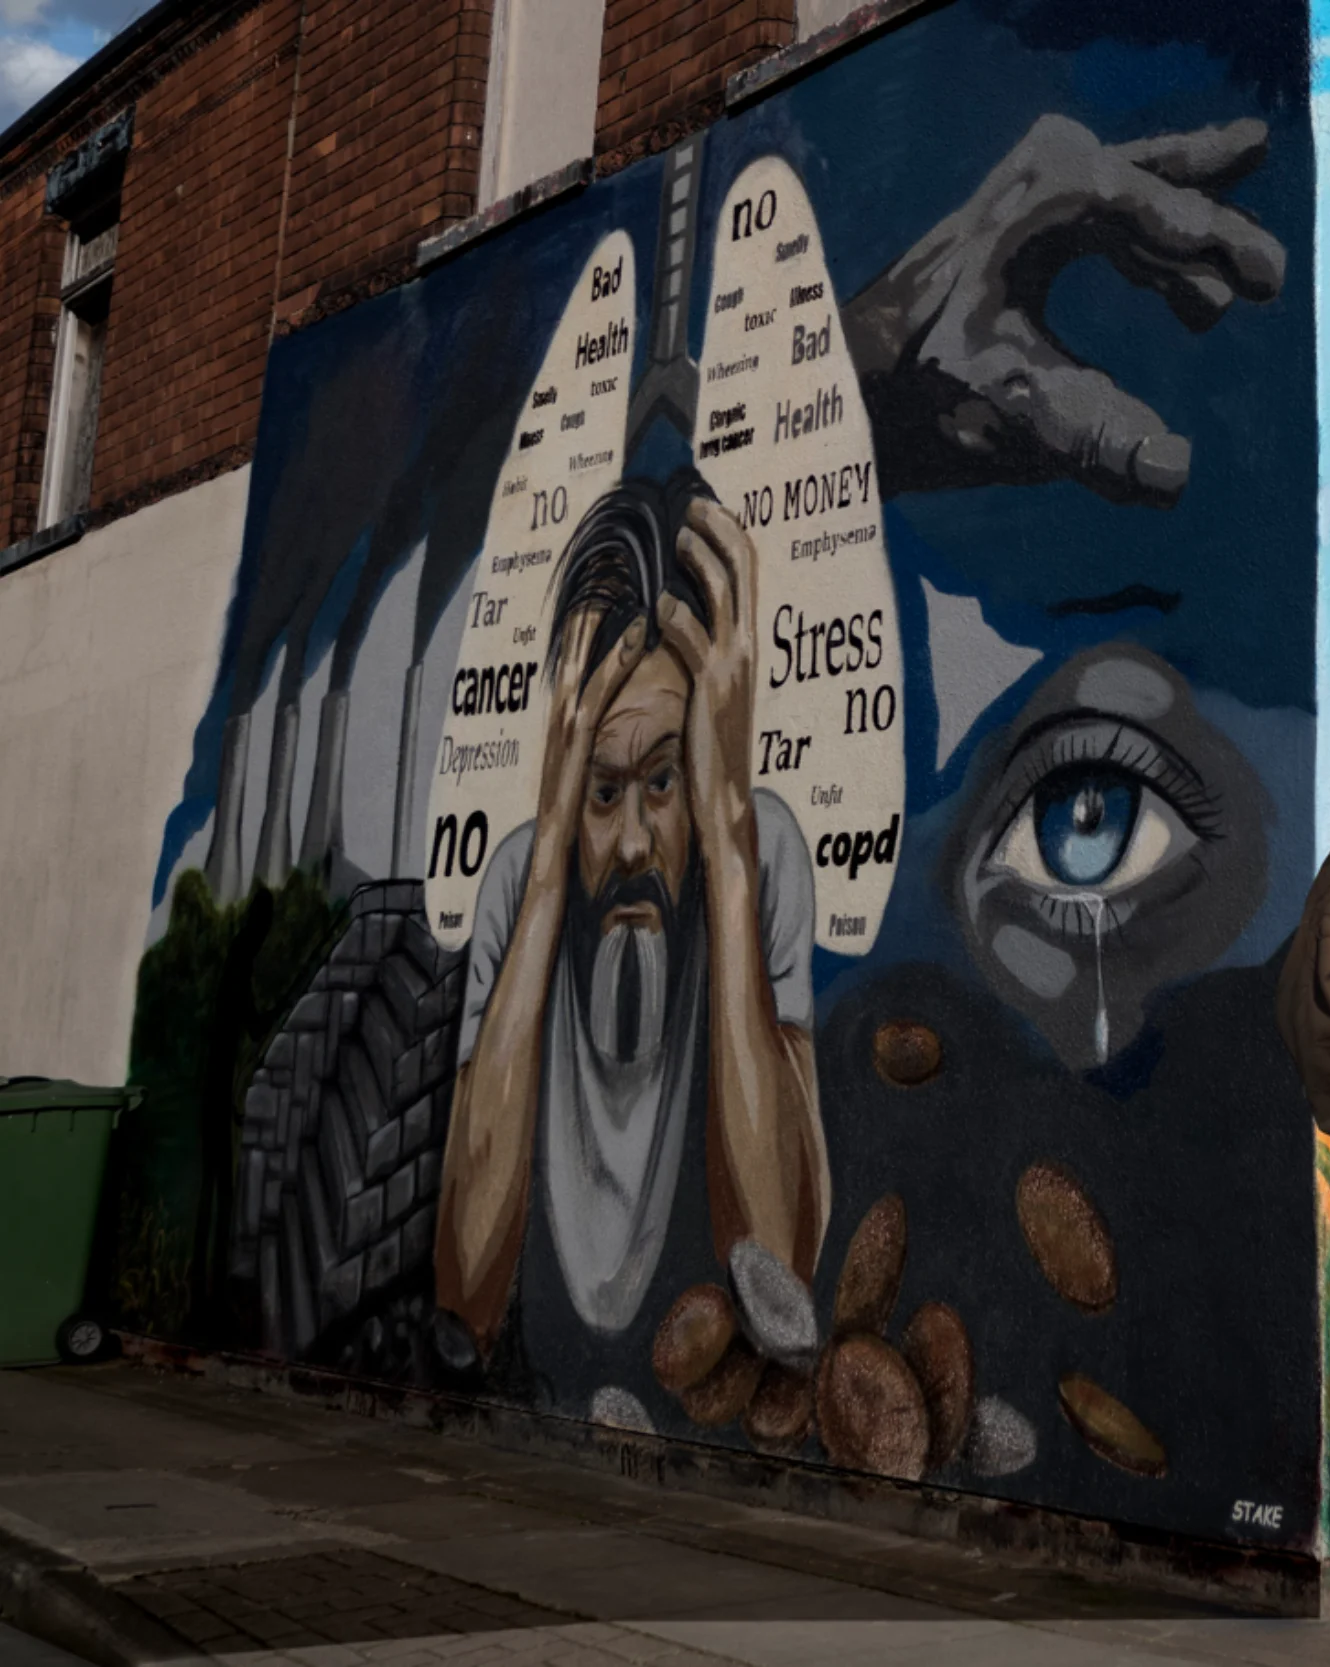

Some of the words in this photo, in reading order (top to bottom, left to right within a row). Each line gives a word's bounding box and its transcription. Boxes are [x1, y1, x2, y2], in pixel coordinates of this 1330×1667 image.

[731, 189, 778, 242] no
[591, 256, 624, 303] Bad
[714, 286, 745, 315] Cough
[744, 308, 778, 333] toxic
[791, 314, 832, 366] Bad
[575, 321, 629, 371] Health
[774, 383, 844, 445] Health
[530, 485, 568, 532] no
[742, 485, 774, 532] NO
[784, 461, 872, 522] MONEY
[492, 550, 553, 577] Emphysema
[791, 524, 877, 562] Emphysema
[471, 590, 509, 629] Tar
[769, 602, 885, 691] Stress
[451, 660, 538, 717] cancer
[843, 684, 897, 736] no
[439, 728, 520, 787] Depression
[757, 730, 812, 777] Tar
[810, 785, 844, 809] Unfit
[427, 809, 489, 880] no
[815, 813, 901, 881] copd
[828, 913, 867, 939] Poison
[1231, 1499, 1284, 1529] STAKE
